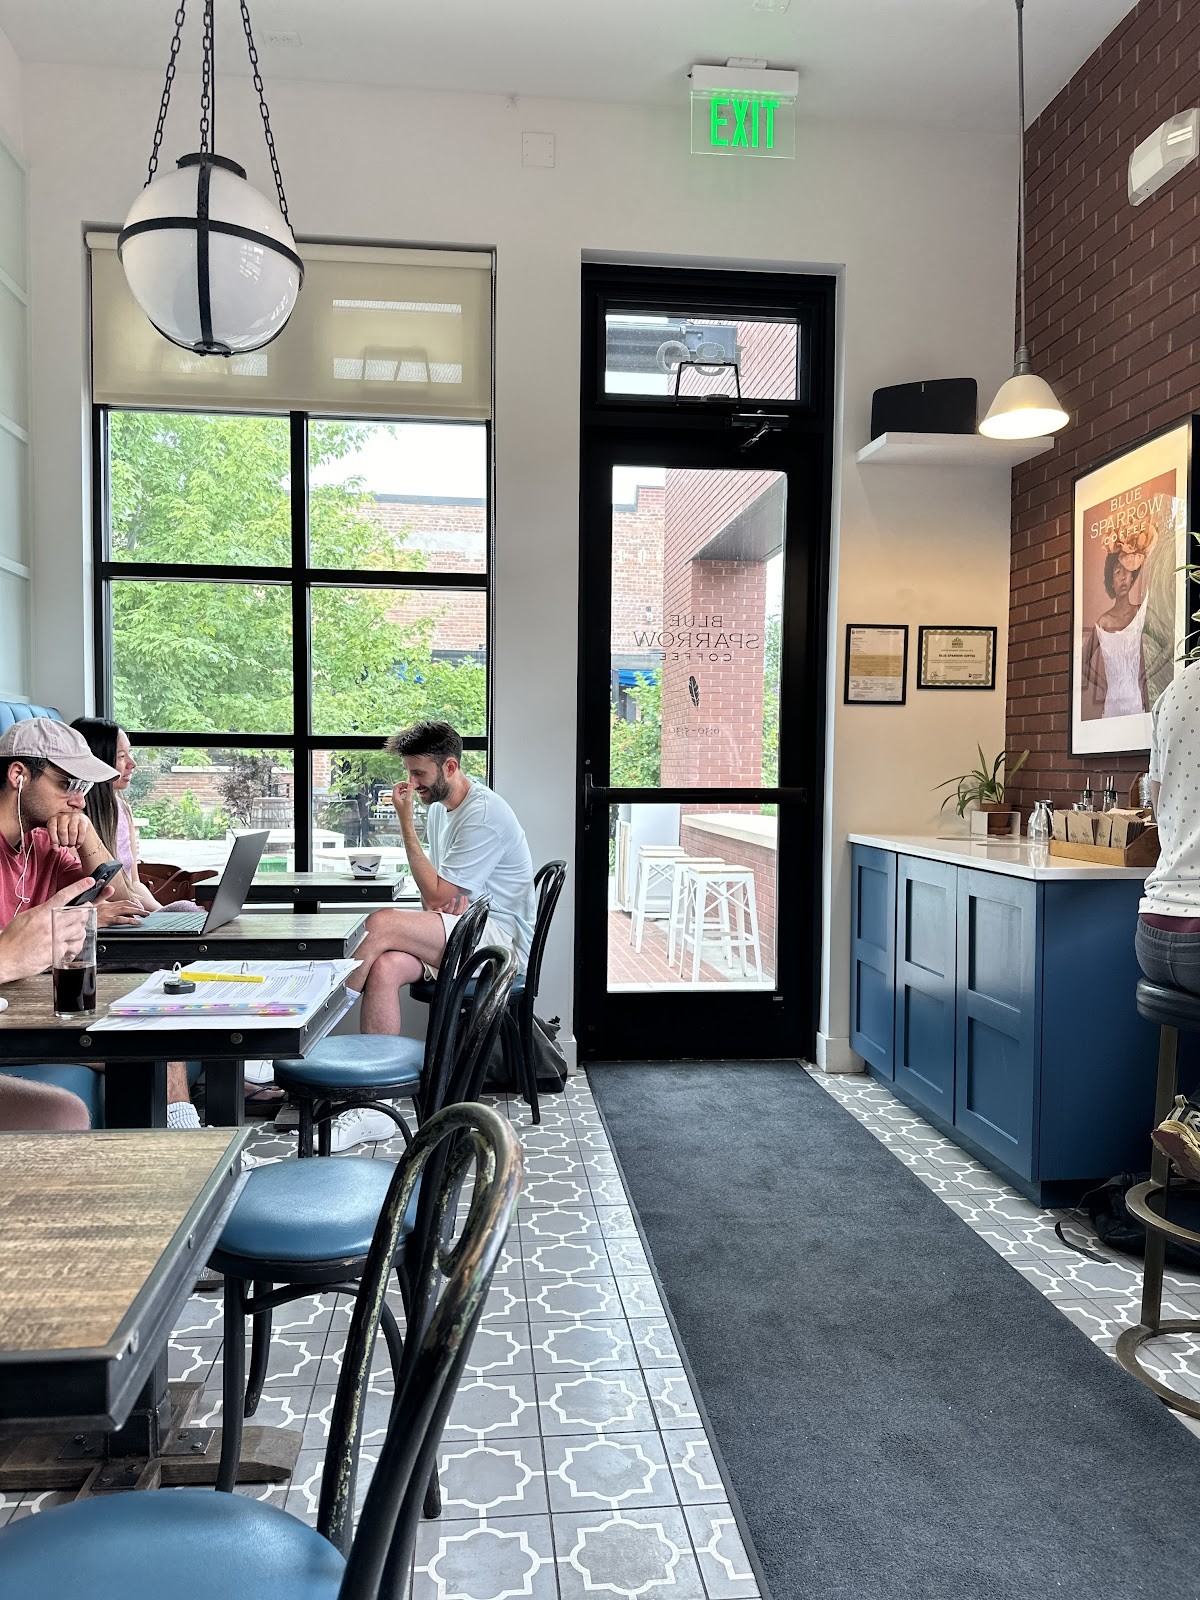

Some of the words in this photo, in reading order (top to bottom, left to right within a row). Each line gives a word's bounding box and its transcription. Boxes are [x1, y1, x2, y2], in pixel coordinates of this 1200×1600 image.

[710, 97, 780, 149] EXIT
[1090, 493, 1165, 539] SPARROW
[1110, 487, 1142, 511] BLUE
[1104, 521, 1147, 545] COFFEE
